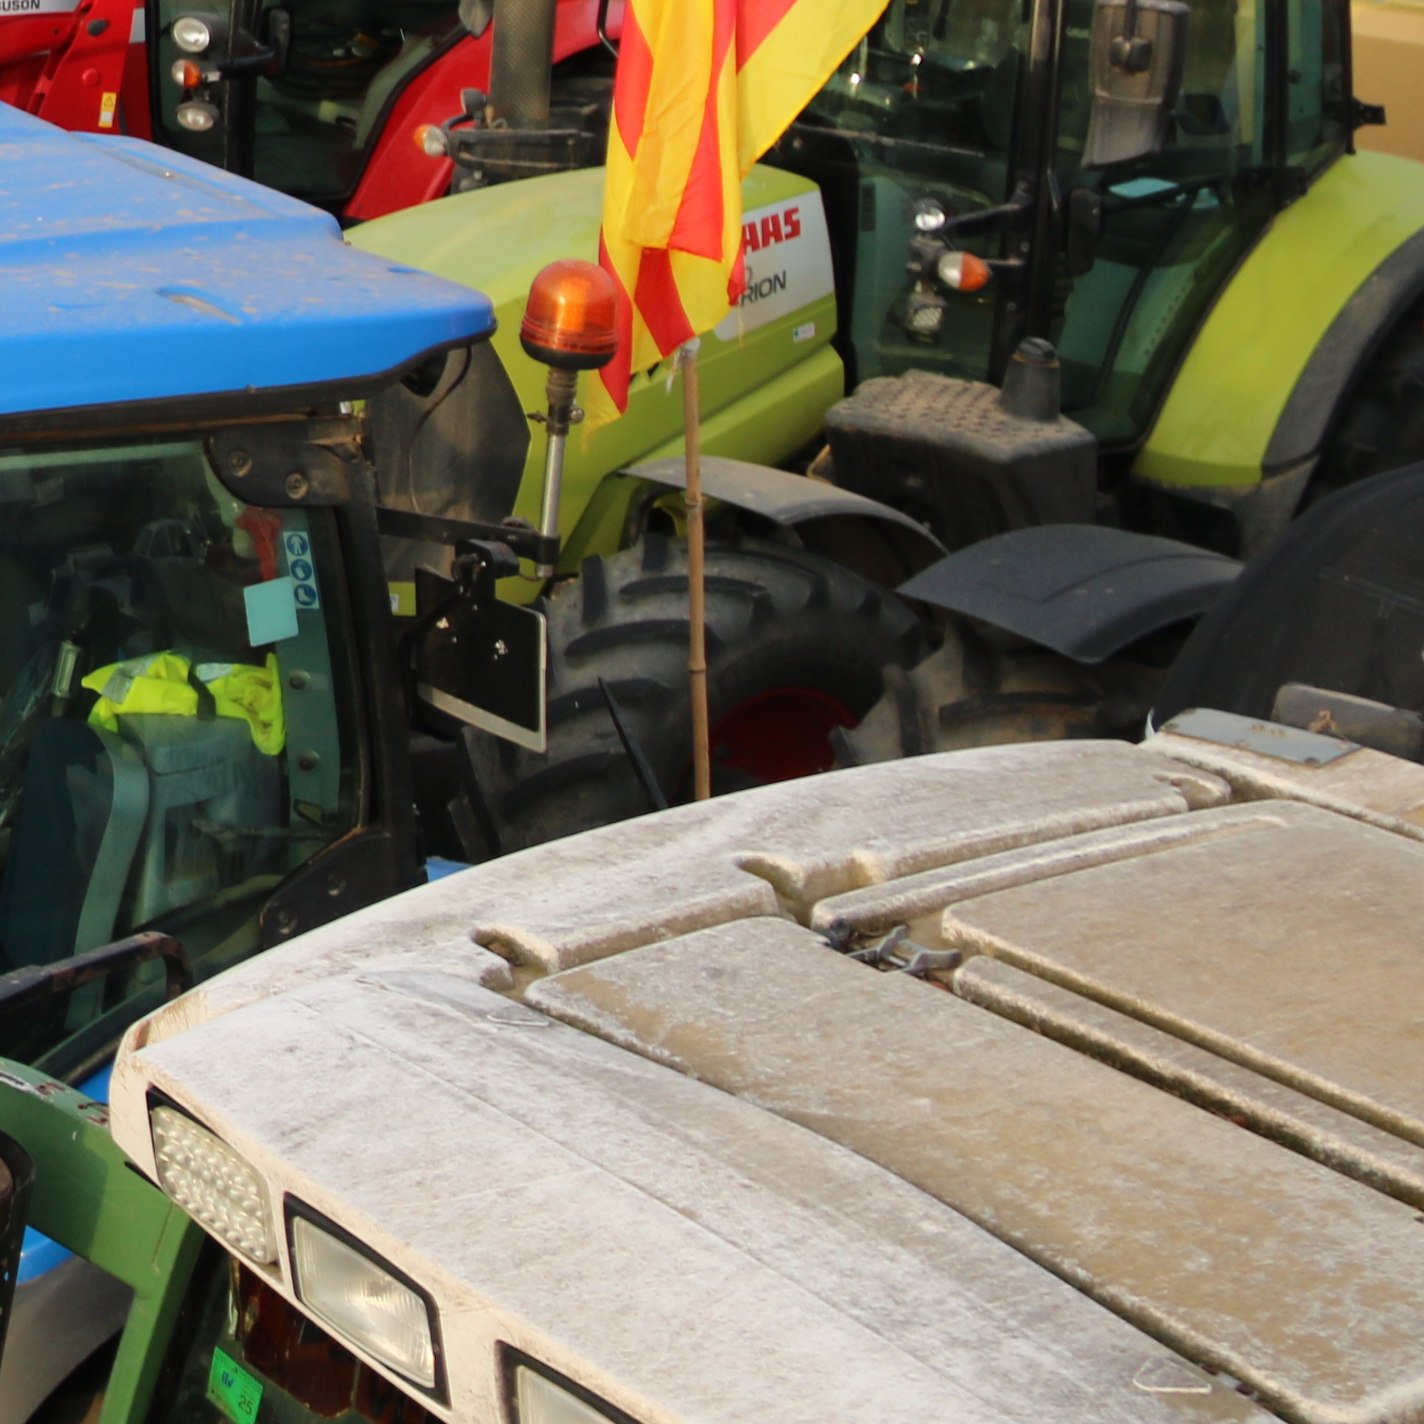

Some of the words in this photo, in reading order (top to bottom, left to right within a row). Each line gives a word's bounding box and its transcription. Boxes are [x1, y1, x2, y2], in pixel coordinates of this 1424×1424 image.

[742, 206, 801, 254] AAS
[740, 269, 787, 307] RION
[238, 1393, 253, 1416] 25
